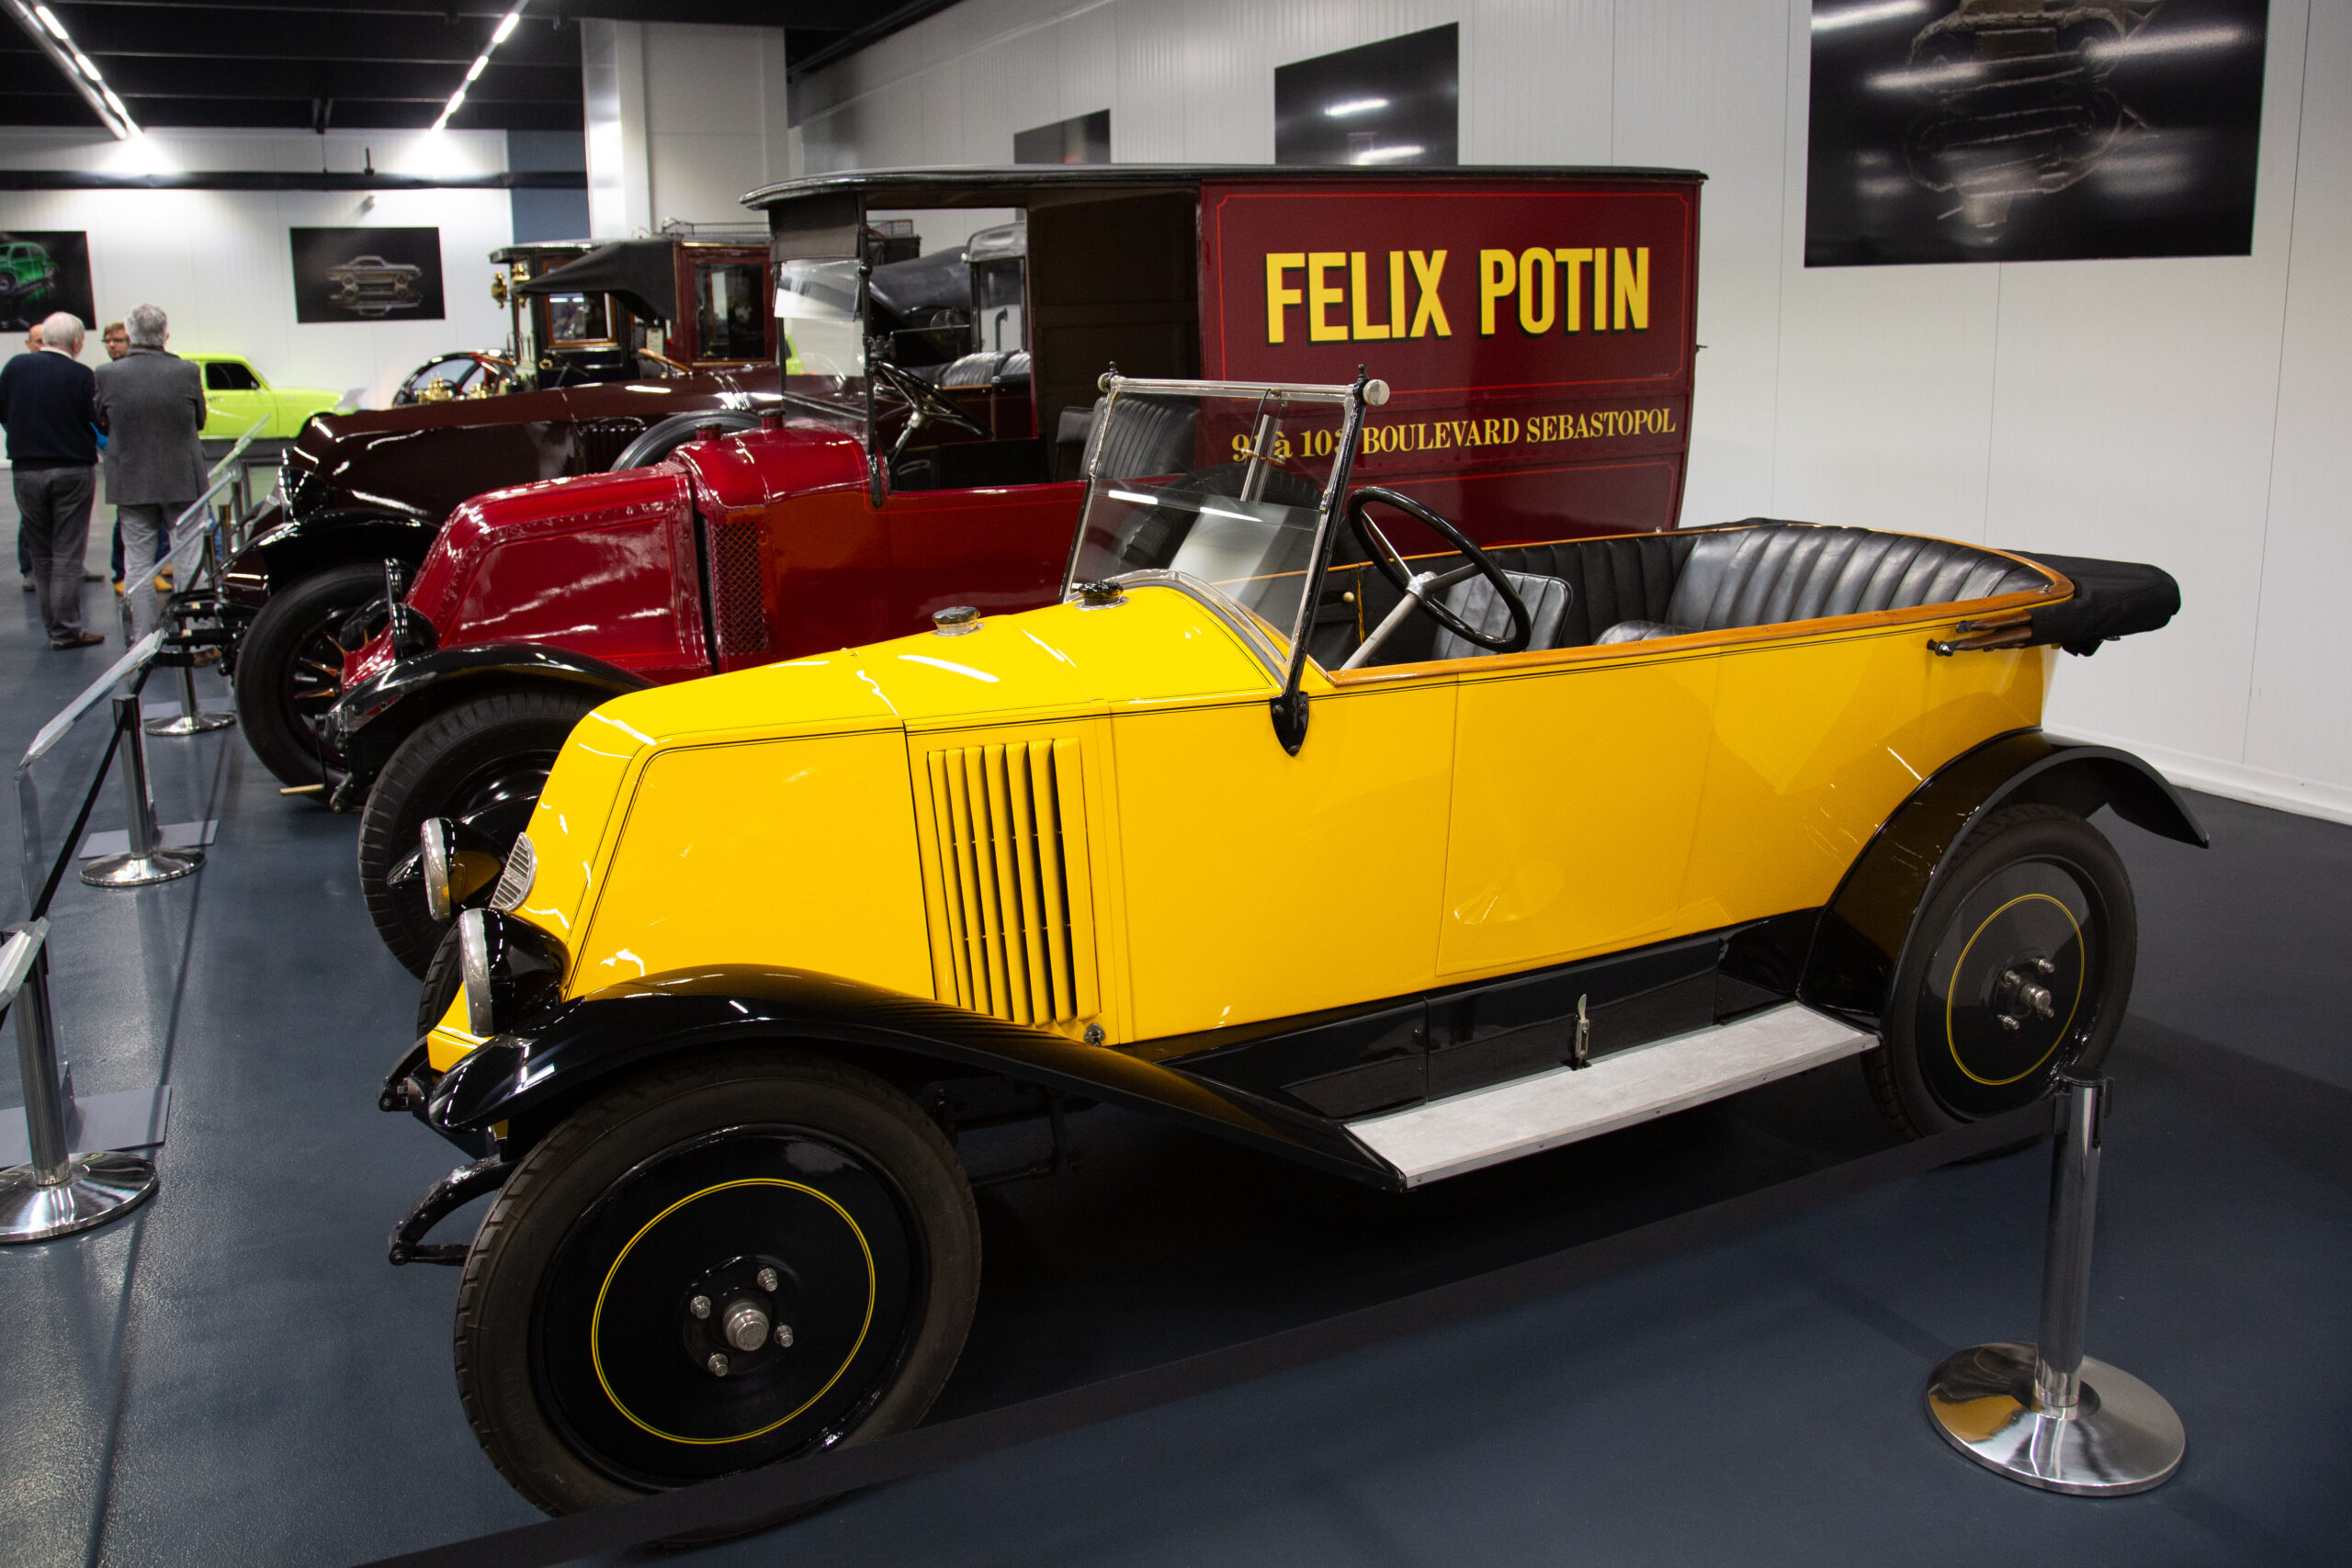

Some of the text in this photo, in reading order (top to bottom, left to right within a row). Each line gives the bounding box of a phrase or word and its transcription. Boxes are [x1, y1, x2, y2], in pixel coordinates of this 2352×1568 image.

[1264, 247, 1649, 344] FELIX POTIN
[1273, 431, 1293, 458] à
[1361, 418, 1519, 456] BOULEVARD
[1526, 407, 1676, 444] SEBASTOPOL
